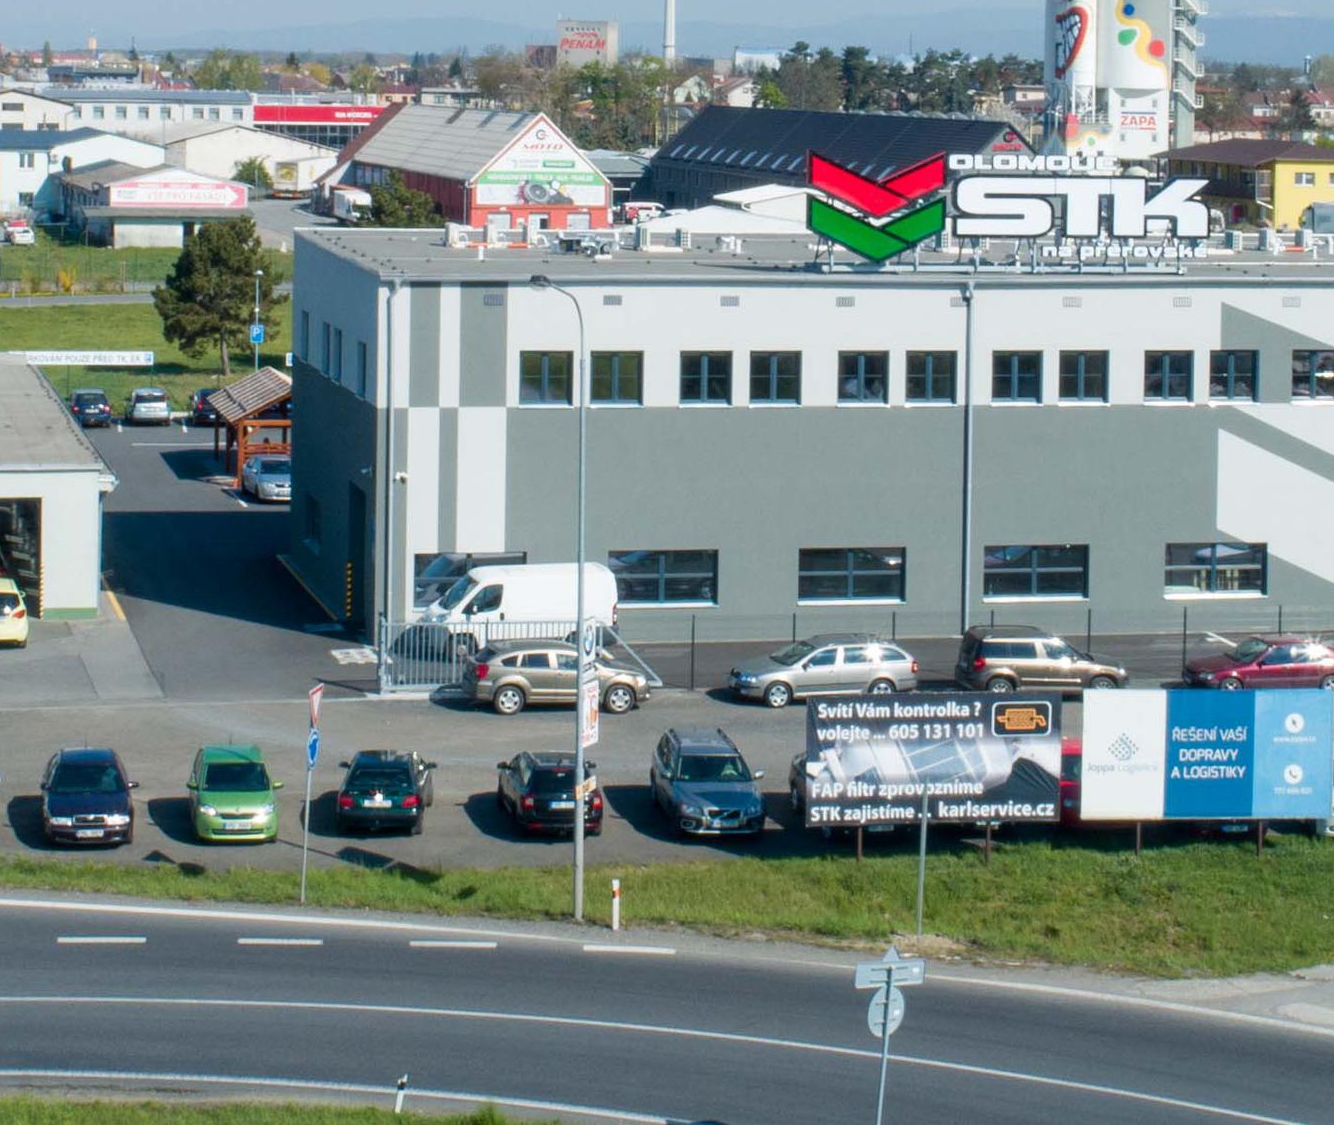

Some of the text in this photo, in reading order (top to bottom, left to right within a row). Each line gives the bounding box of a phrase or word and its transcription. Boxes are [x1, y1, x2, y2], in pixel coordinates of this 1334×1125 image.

[1121, 115, 1166, 126] ZAPA
[948, 153, 1118, 171] OLOMOUC
[954, 174, 1210, 238] STK
[1042, 242, 1208, 261] na přerovské
[818, 701, 982, 720] Svítí Vám kontrolka ?
[817, 724, 870, 743] volejte
[888, 724, 920, 740] 605
[923, 723, 950, 739] 131
[956, 722, 984, 739] 101
[1172, 724, 1247, 742] ŘEŠENÍ VAŠÍ
[1178, 747, 1239, 762] DOPRAVY
[1087, 761, 1115, 775] Joppa
[1170, 764, 1247, 780] A LOGISTIKY
[812, 778, 984, 799] FAP filtr zprovozníme
[810, 805, 841, 821] STK
[843, 804, 915, 825] zajistíme
[938, 800, 1055, 820] karlservice.cz
